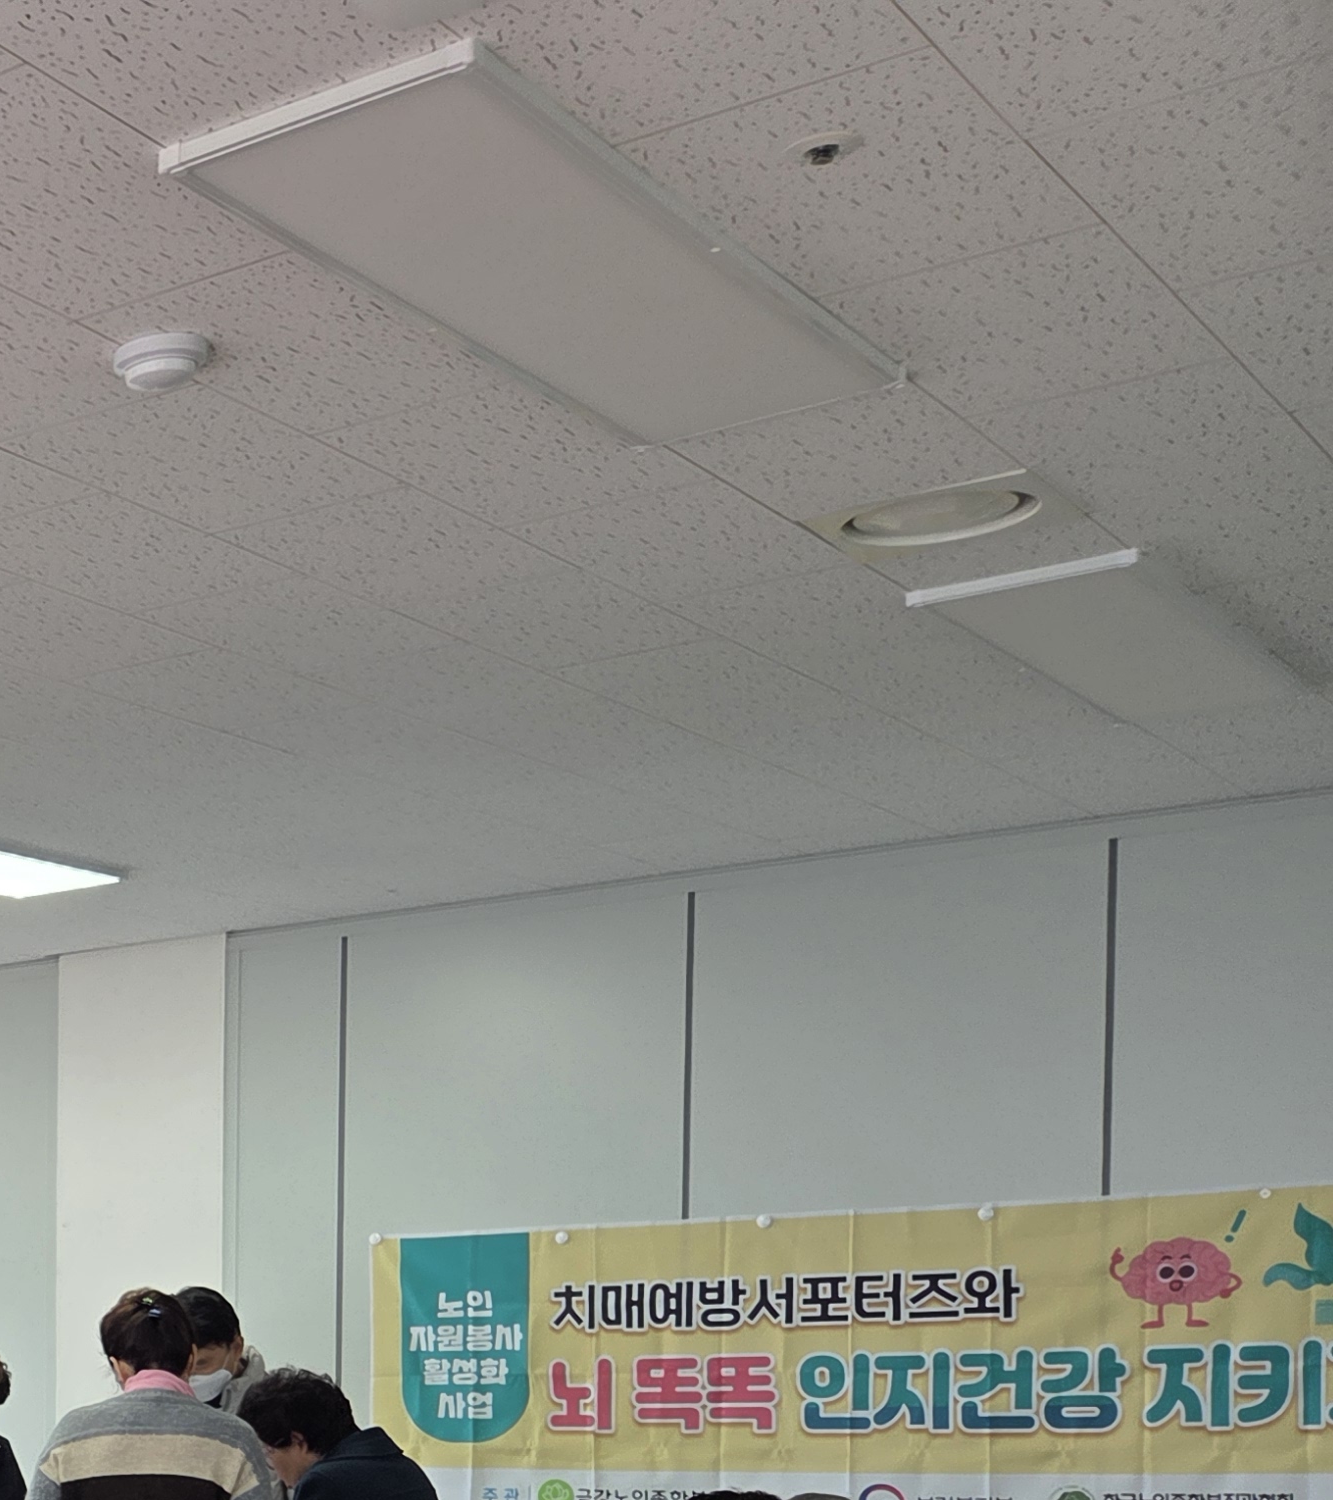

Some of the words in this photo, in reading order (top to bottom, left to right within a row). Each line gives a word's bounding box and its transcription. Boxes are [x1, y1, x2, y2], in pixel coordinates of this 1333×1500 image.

[437, 1290, 493, 1318] 노인
[551, 1267, 1022, 1331] 치매예방서포터즈와
[409, 1323, 523, 1352] 자원봉사
[423, 1358, 509, 1386] 활성화
[547, 1355, 614, 1432] 뇌
[633, 1354, 777, 1433] 똑똑
[798, 1345, 1128, 1432] 인지건강
[1144, 1339, 1333, 1430] 지키
[437, 1391, 493, 1419] 사업
